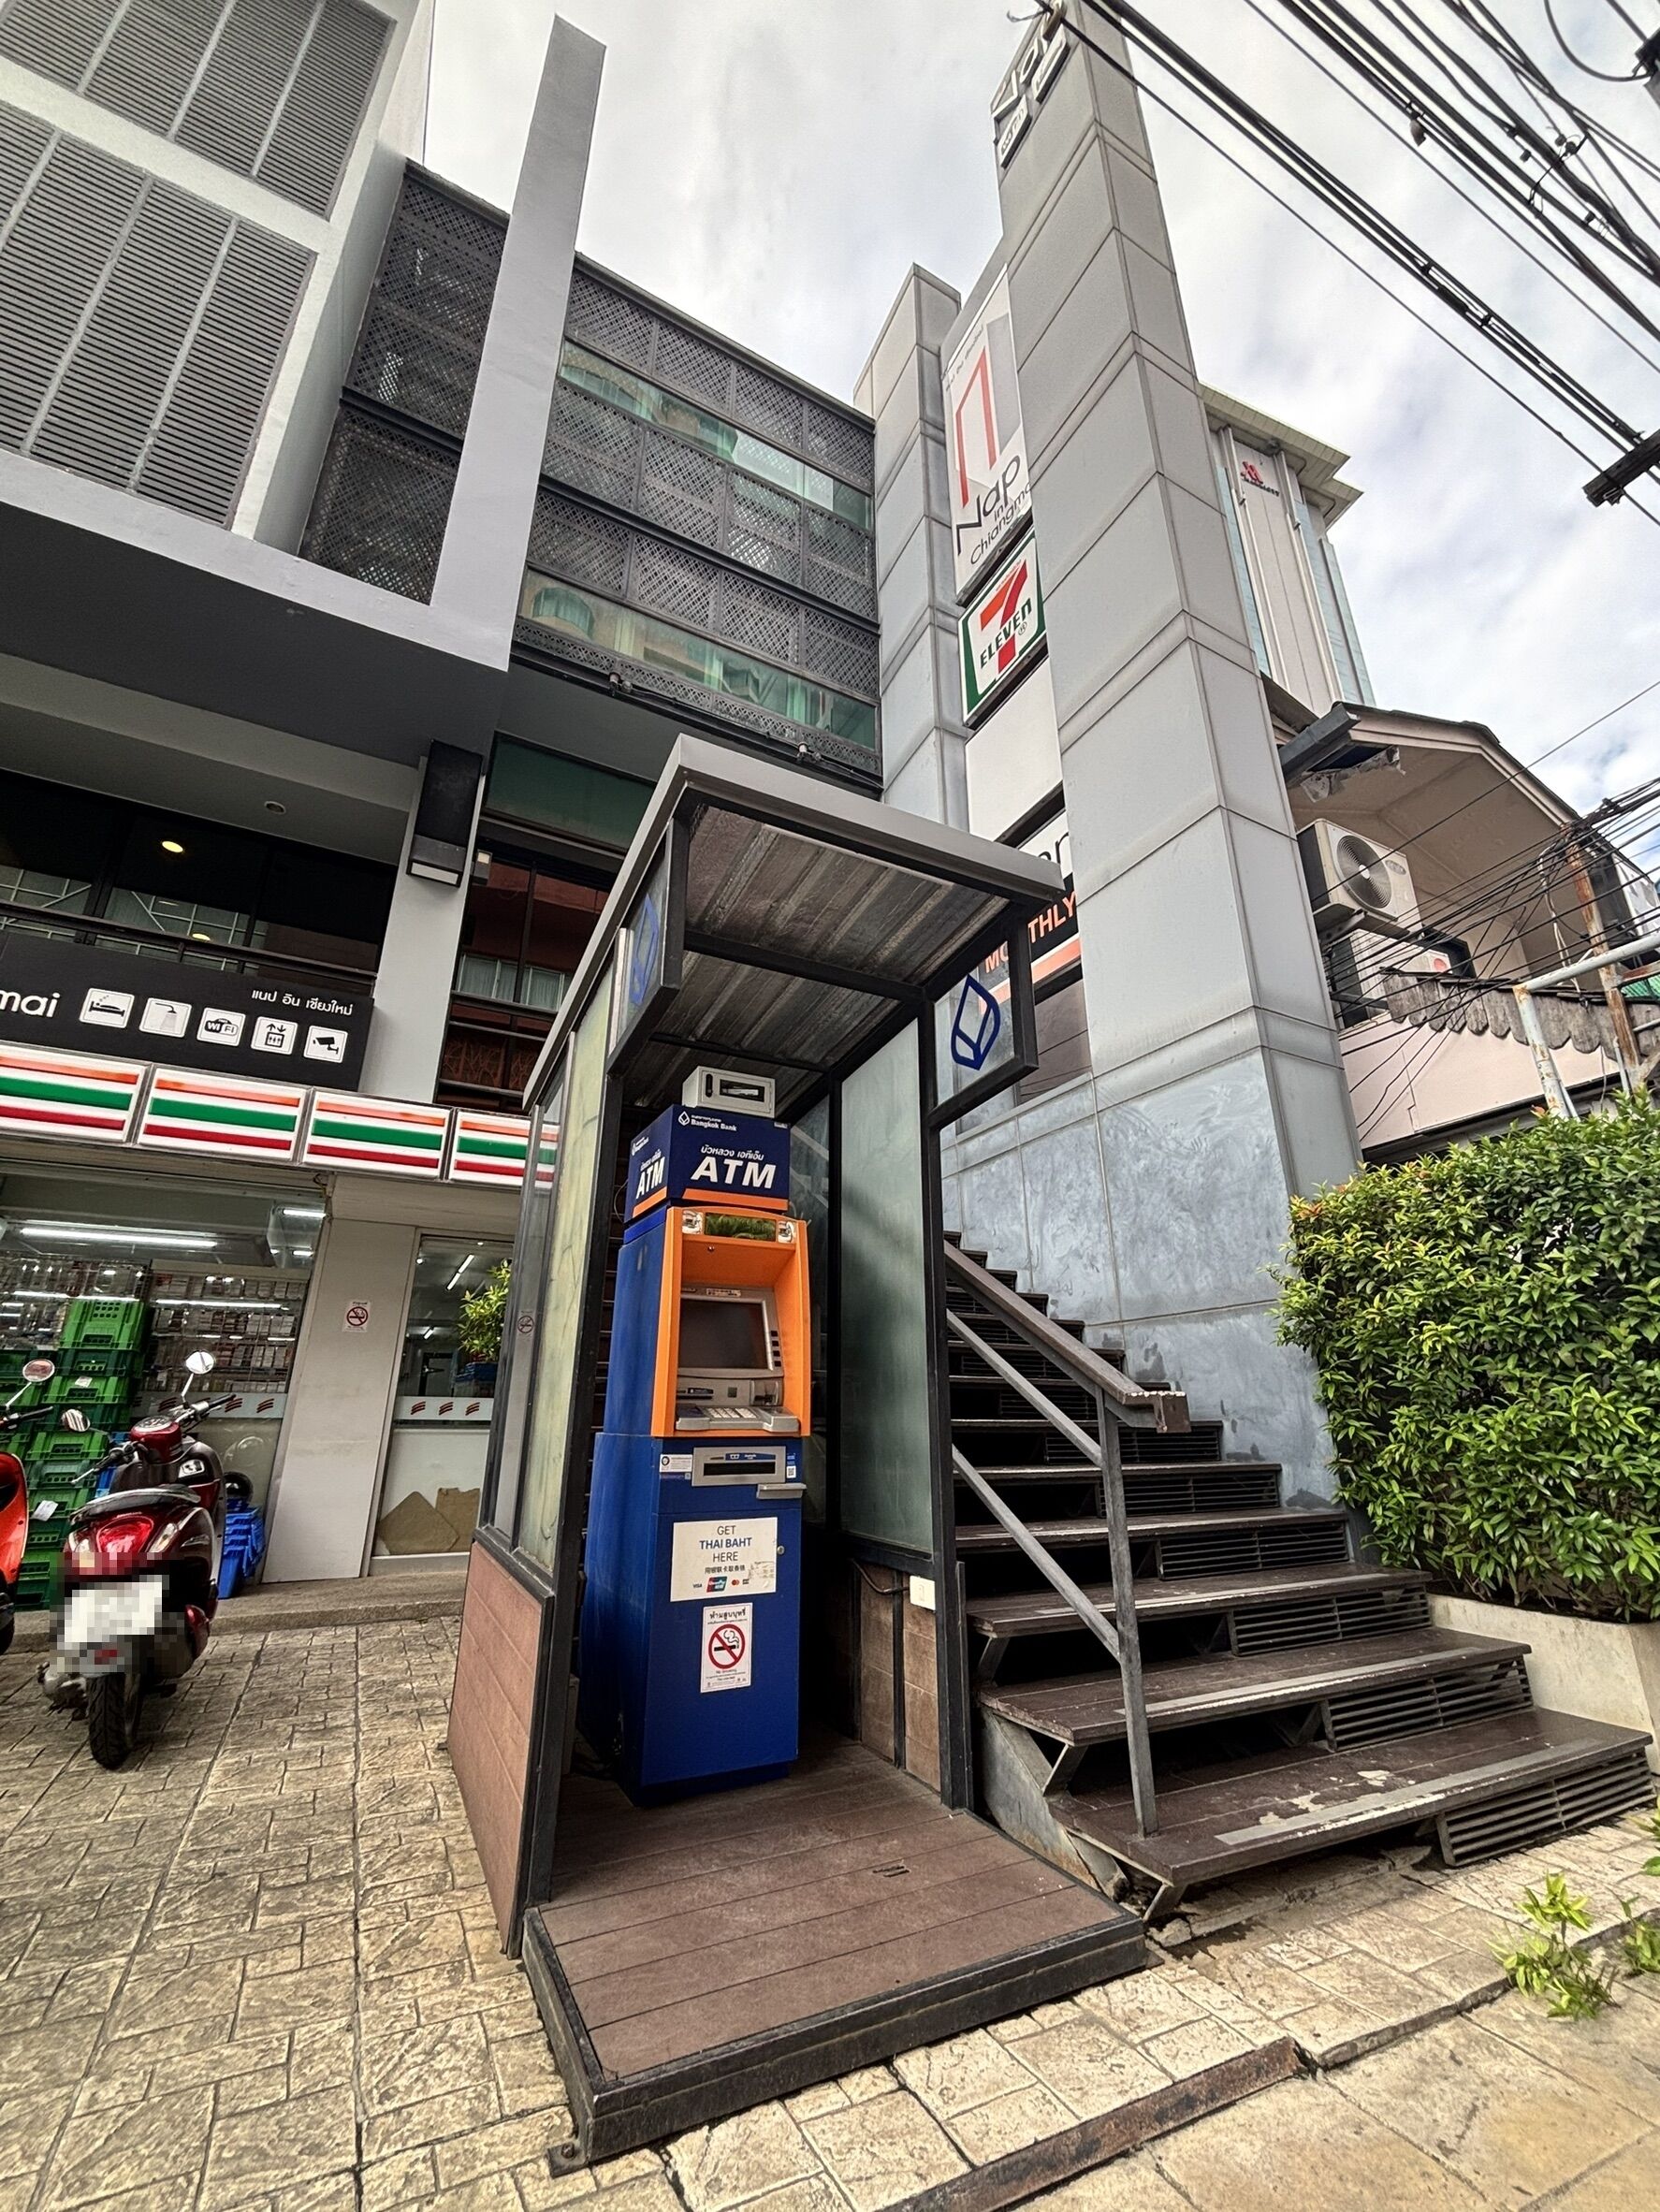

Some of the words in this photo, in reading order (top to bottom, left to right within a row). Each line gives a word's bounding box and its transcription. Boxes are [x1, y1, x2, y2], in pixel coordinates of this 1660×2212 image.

[956, 455, 1021, 556] Nap
[994, 505, 1004, 522] in
[252, 988, 278, 1003] แนป
[282, 993, 300, 1008] อิน
[305, 997, 354, 1016] เชียงใหม่
[691, 1119, 720, 1129] Bangkok
[721, 1124, 737, 1132] Bank
[701, 1144, 735, 1157] บัวหลวง
[737, 1150, 764, 1161] เอทีเอ็ม
[635, 1157, 665, 1200] ATM
[691, 1156, 777, 1189] ATM
[717, 1525, 736, 1535] GET
[699, 1539, 723, 1550] THAI
[725, 1537, 752, 1549] BAHT
[712, 1551, 738, 1563] HERE
